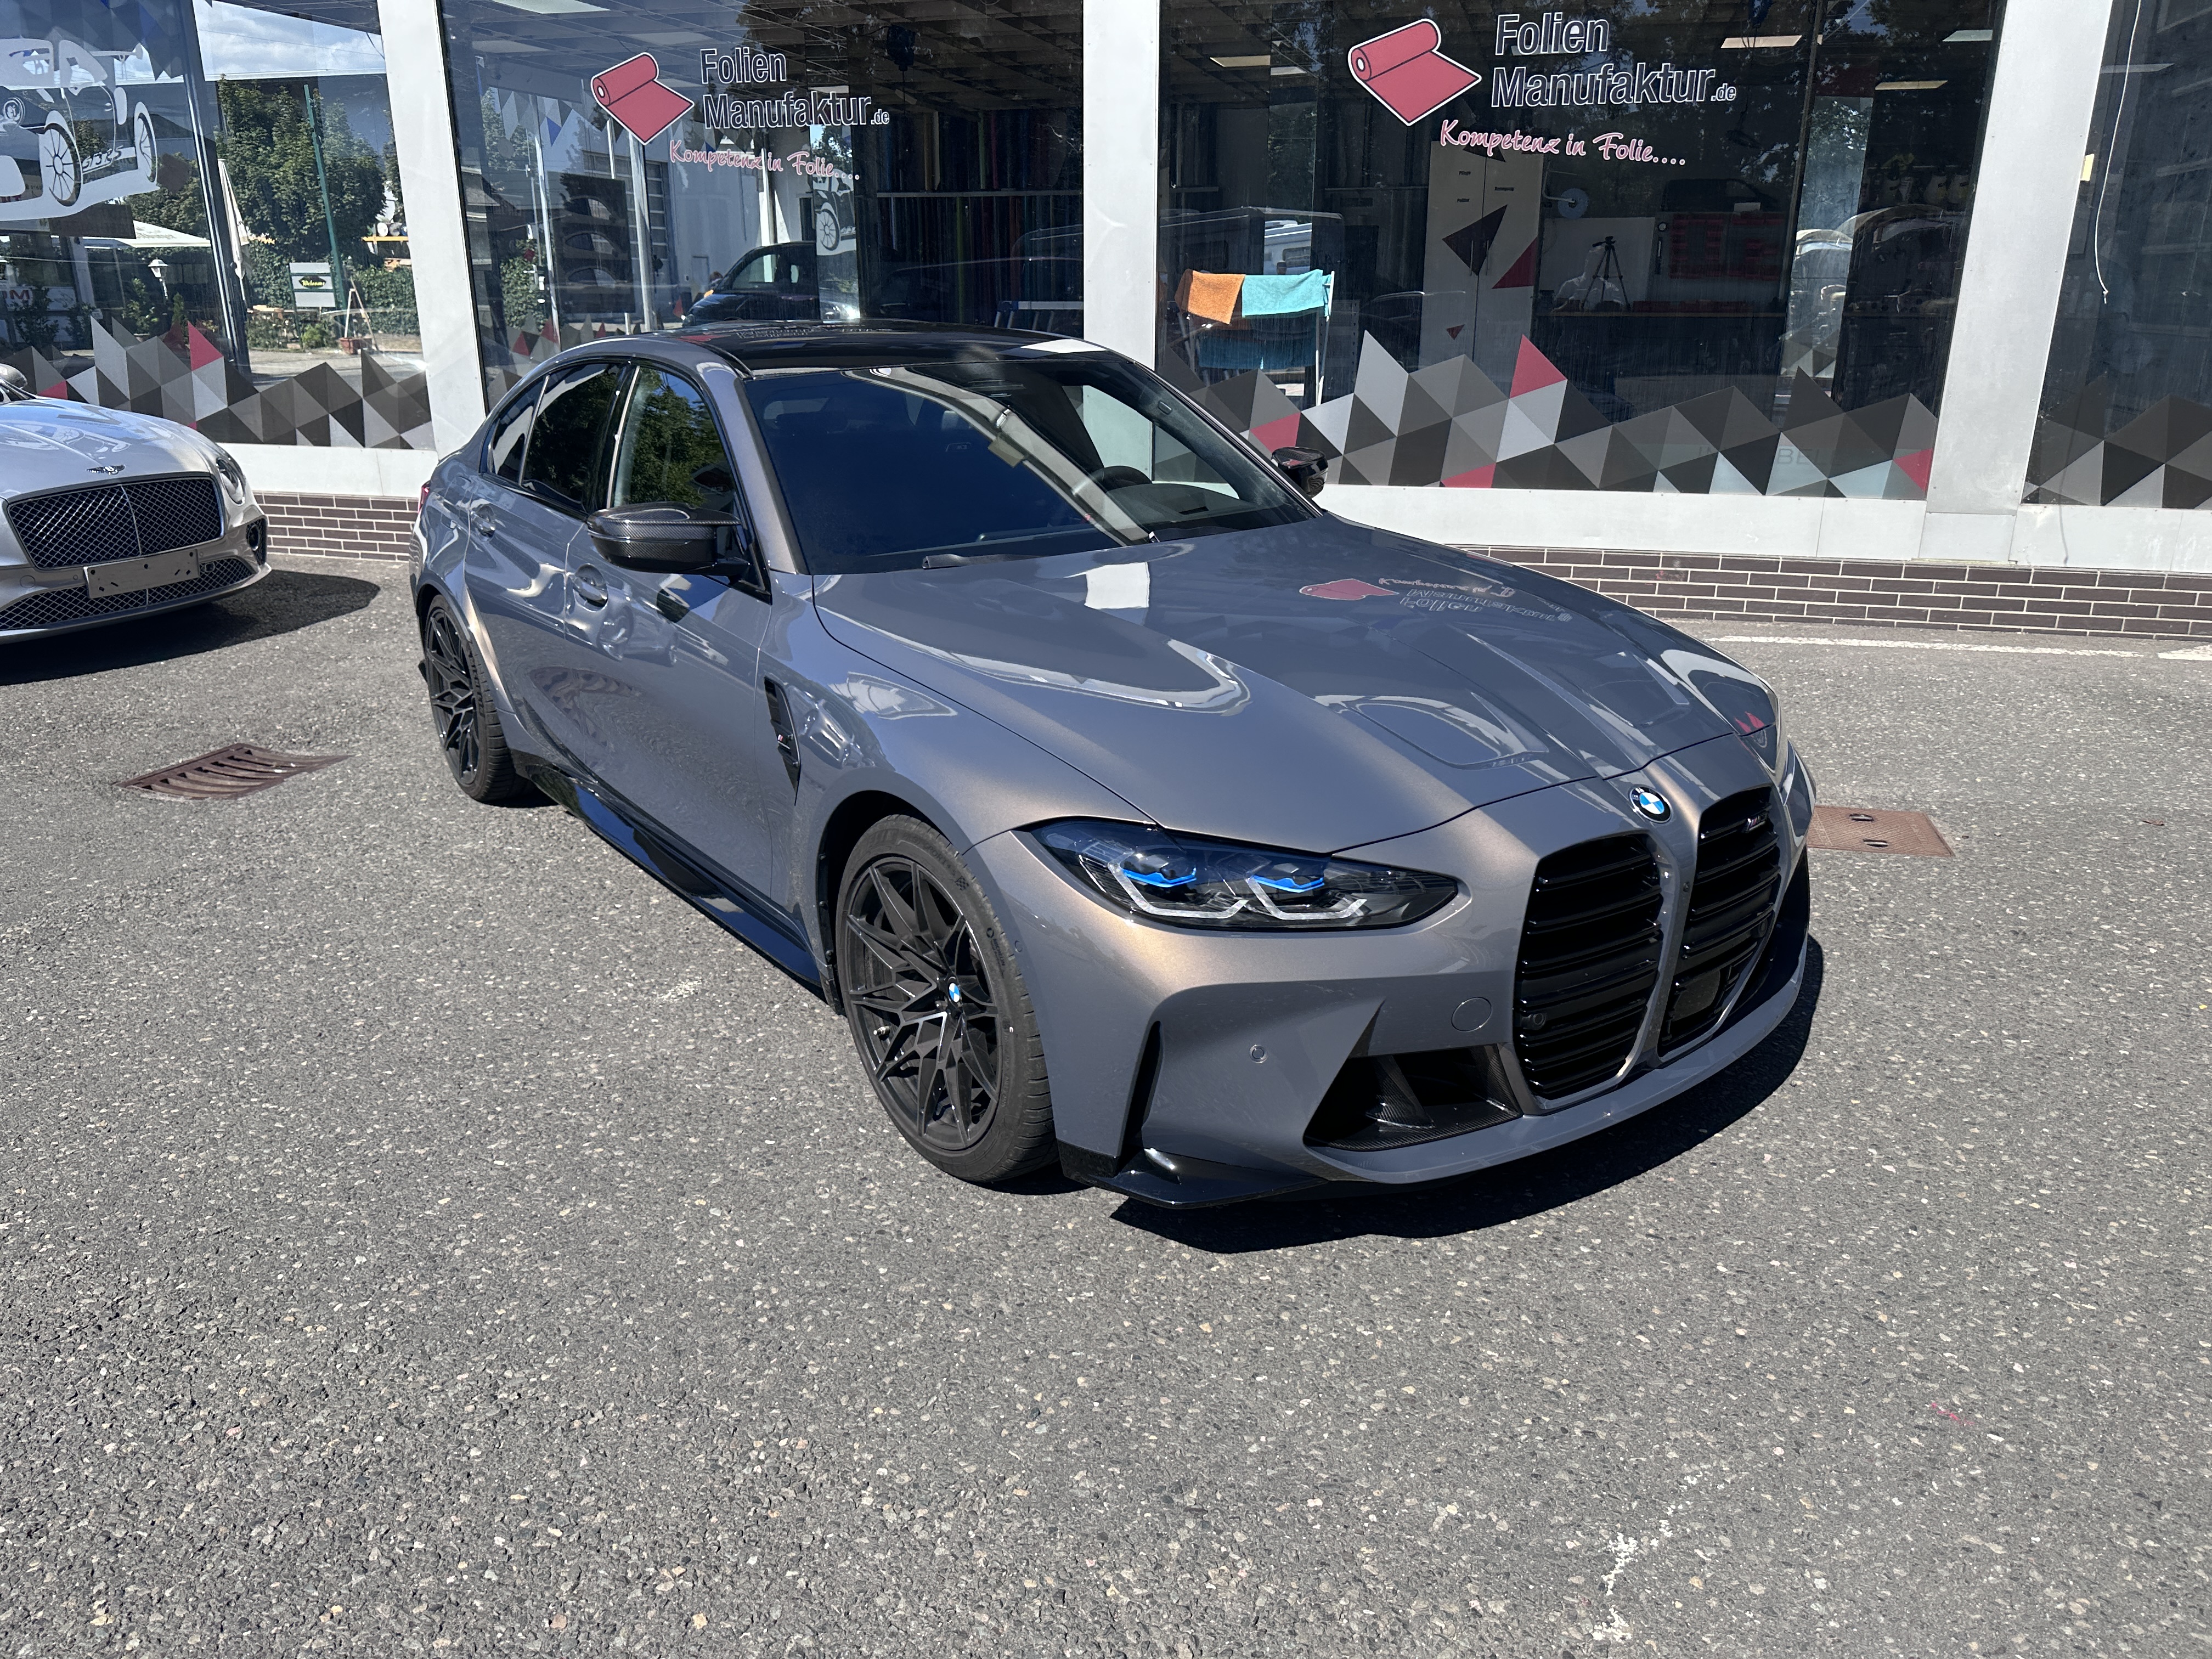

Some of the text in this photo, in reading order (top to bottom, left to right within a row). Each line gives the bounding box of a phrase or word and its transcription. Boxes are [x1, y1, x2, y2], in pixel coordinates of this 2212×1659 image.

[1495, 12, 1609, 55] Folien
[700, 47, 787, 84] Folien
[1491, 63, 1736, 108] Manufaktur.de
[703, 91, 890, 129] Manufaktur.de
[669, 140, 763, 172] Kompetenz
[767, 152, 783, 172] in
[1440, 119, 1561, 156] Kompetenz
[1565, 133, 1587, 156] in
